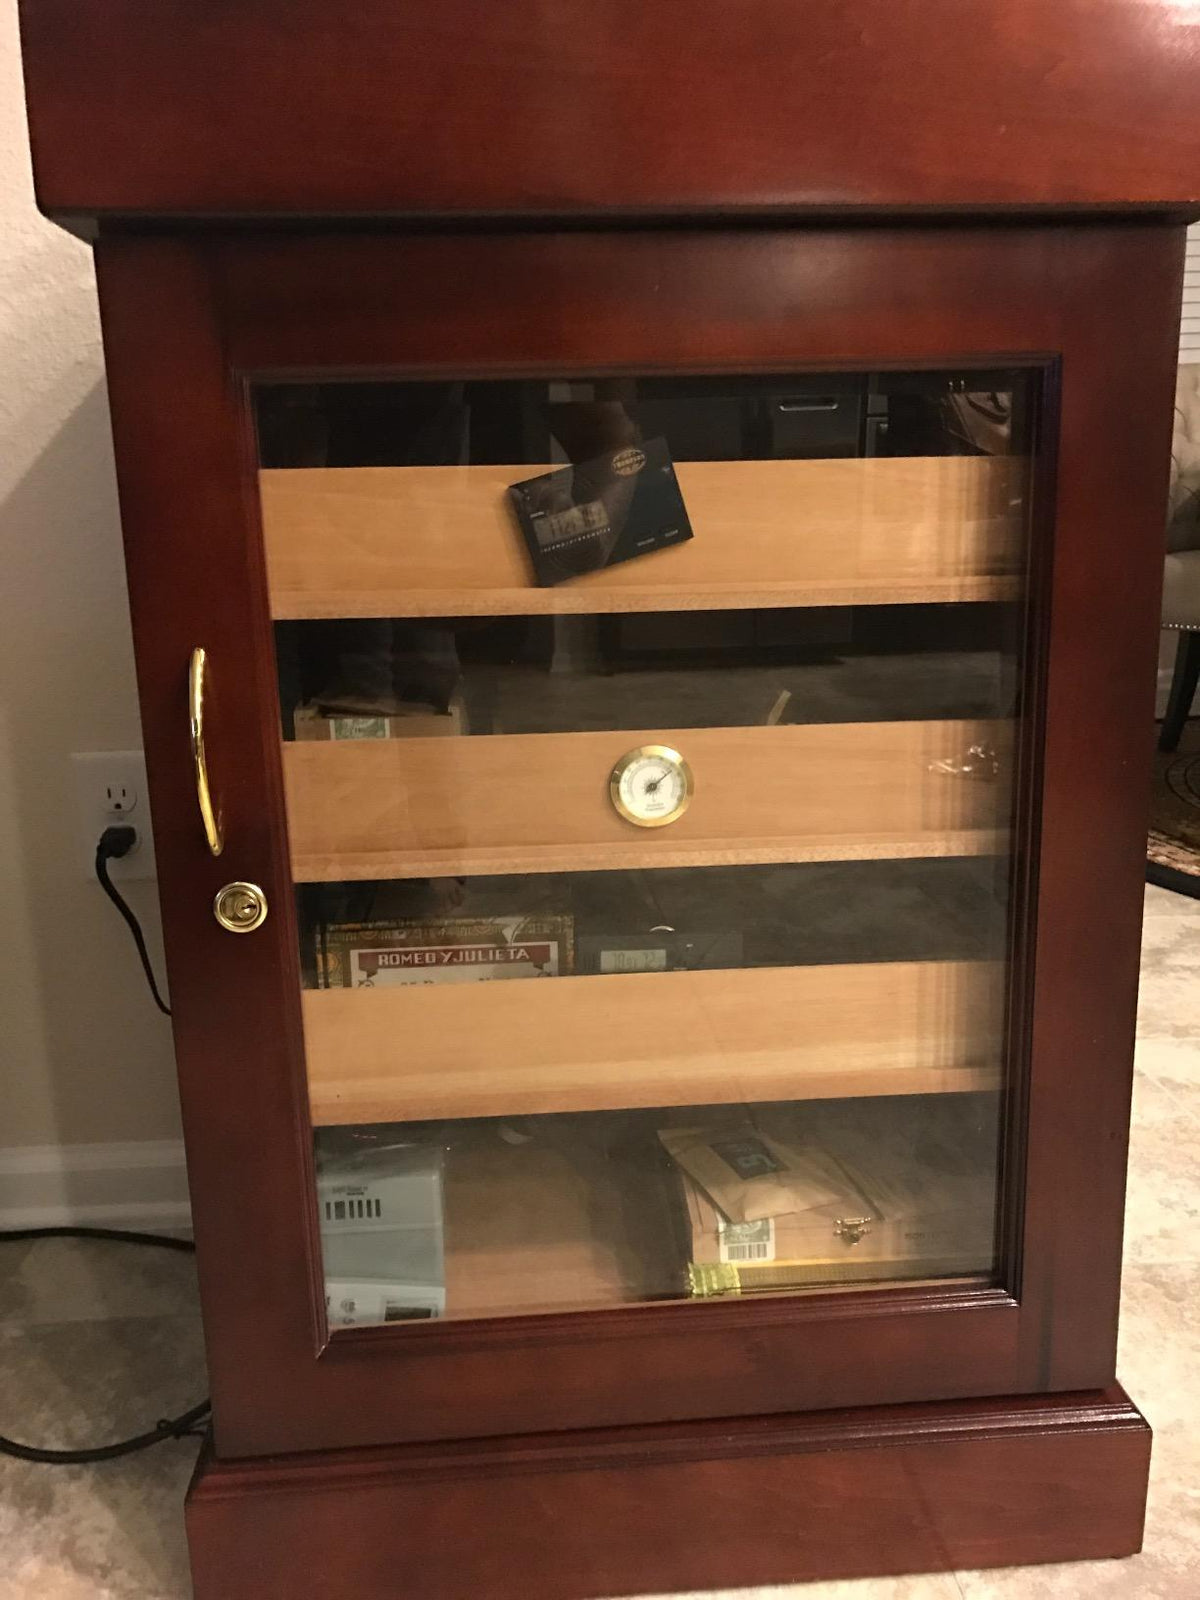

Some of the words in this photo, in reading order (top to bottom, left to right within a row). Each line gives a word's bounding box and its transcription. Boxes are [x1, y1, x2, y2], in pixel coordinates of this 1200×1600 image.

[378, 952, 436, 966] ROMEO
[440, 951, 453, 963] Y
[453, 948, 529, 963] JULIETA
